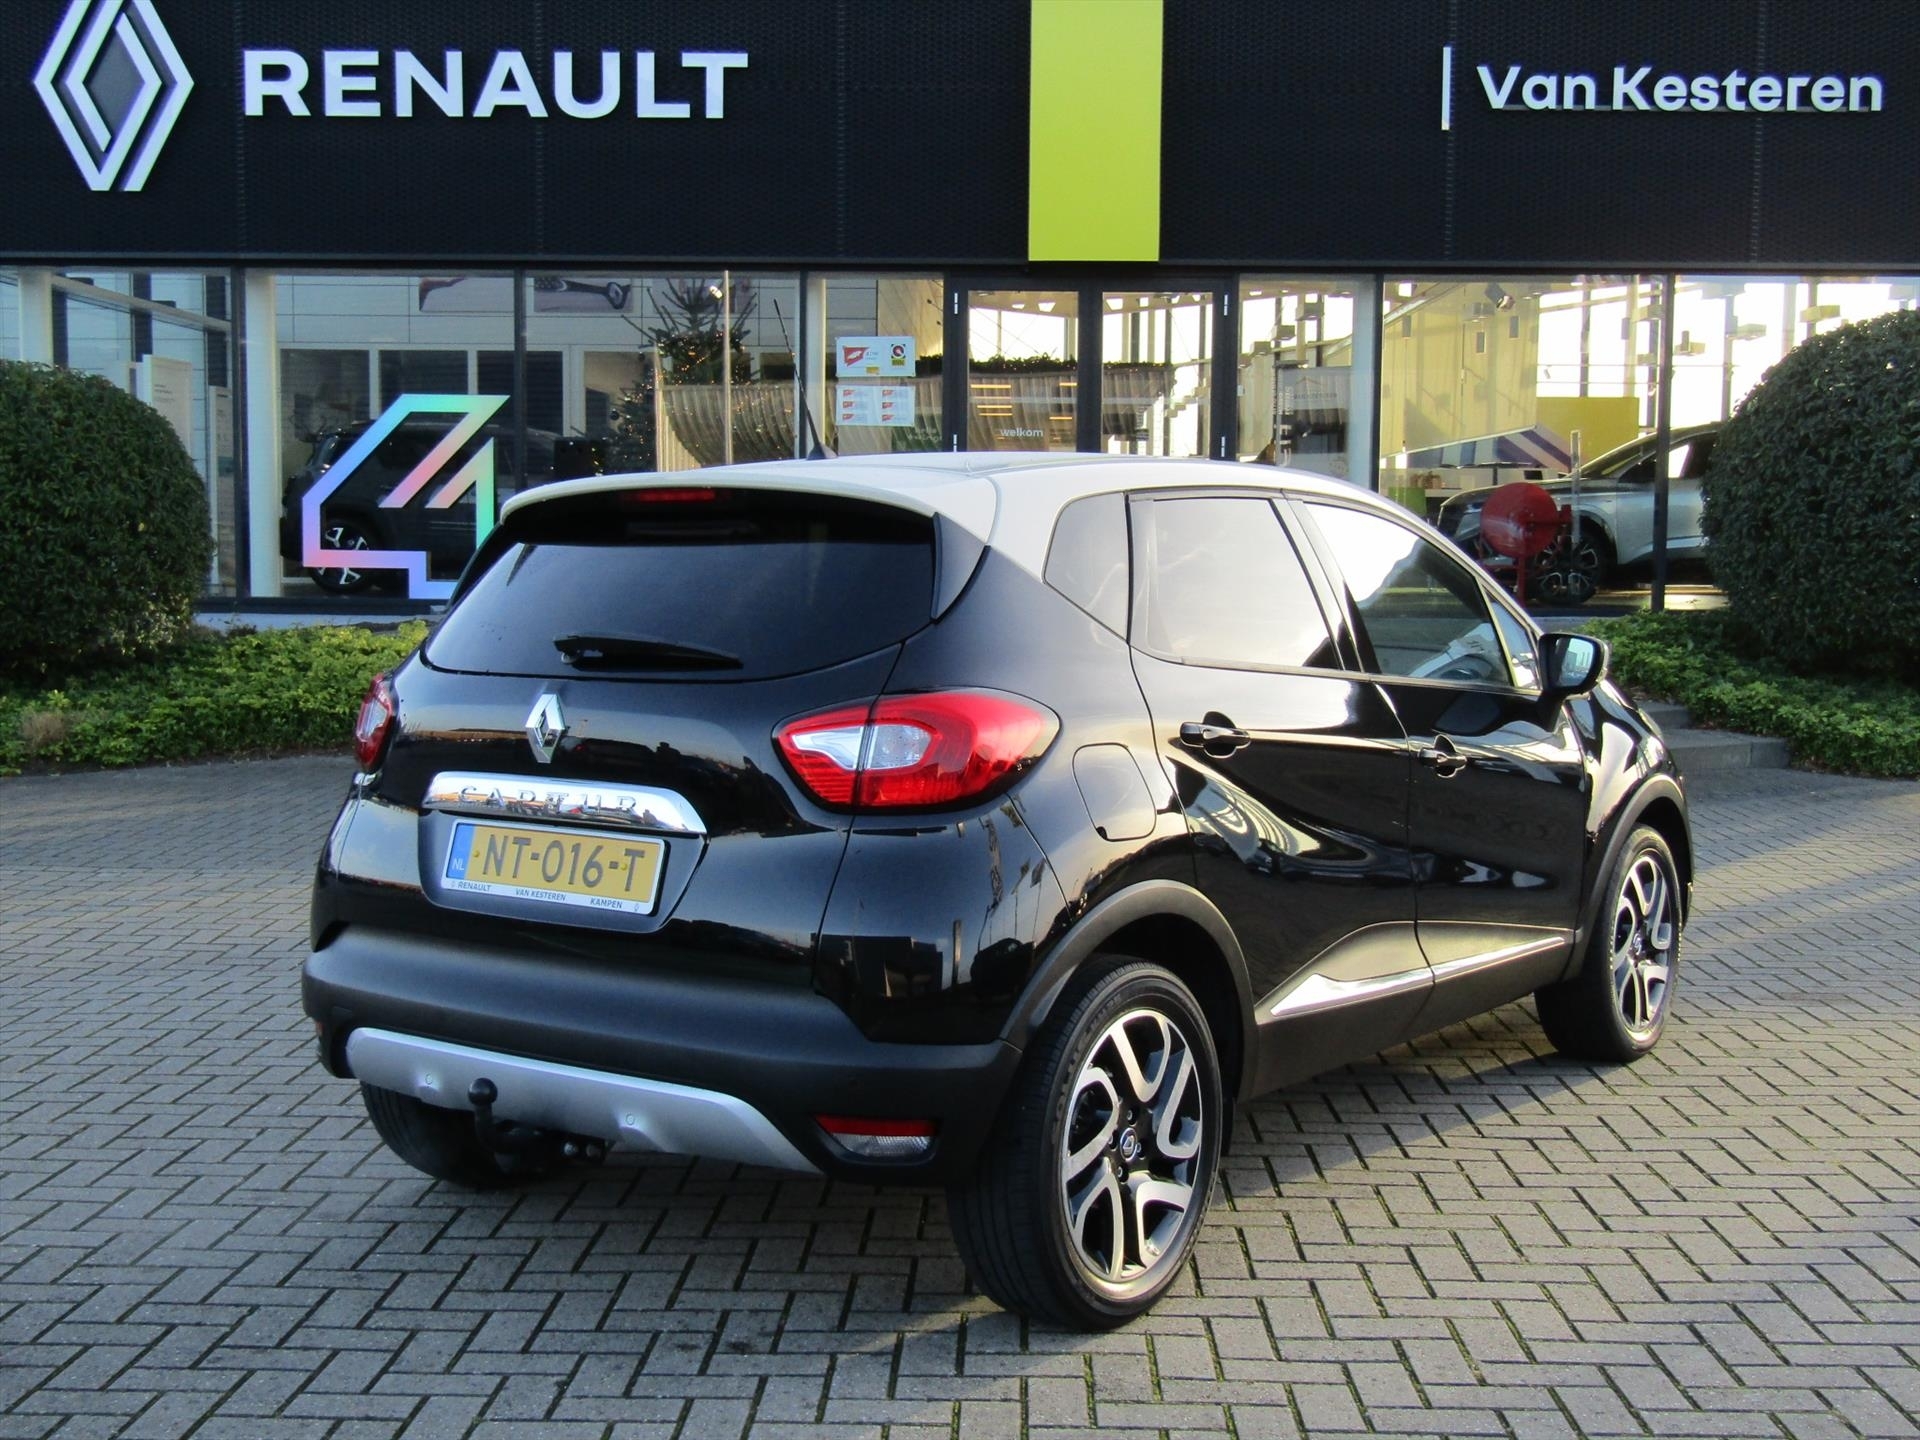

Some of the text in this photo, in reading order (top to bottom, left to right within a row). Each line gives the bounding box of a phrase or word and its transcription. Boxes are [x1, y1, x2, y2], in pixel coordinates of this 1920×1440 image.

[243, 50, 749, 119] RENAULT
[1476, 65, 1883, 112] Van Kesteren
[1000, 427, 1044, 438] welkom
[457, 785, 639, 813] CAPTUR
[453, 859, 465, 872] NL
[482, 834, 645, 892] NT-016-T
[458, 881, 623, 909] RENAULT VAN KESTEREN KAMPEN
